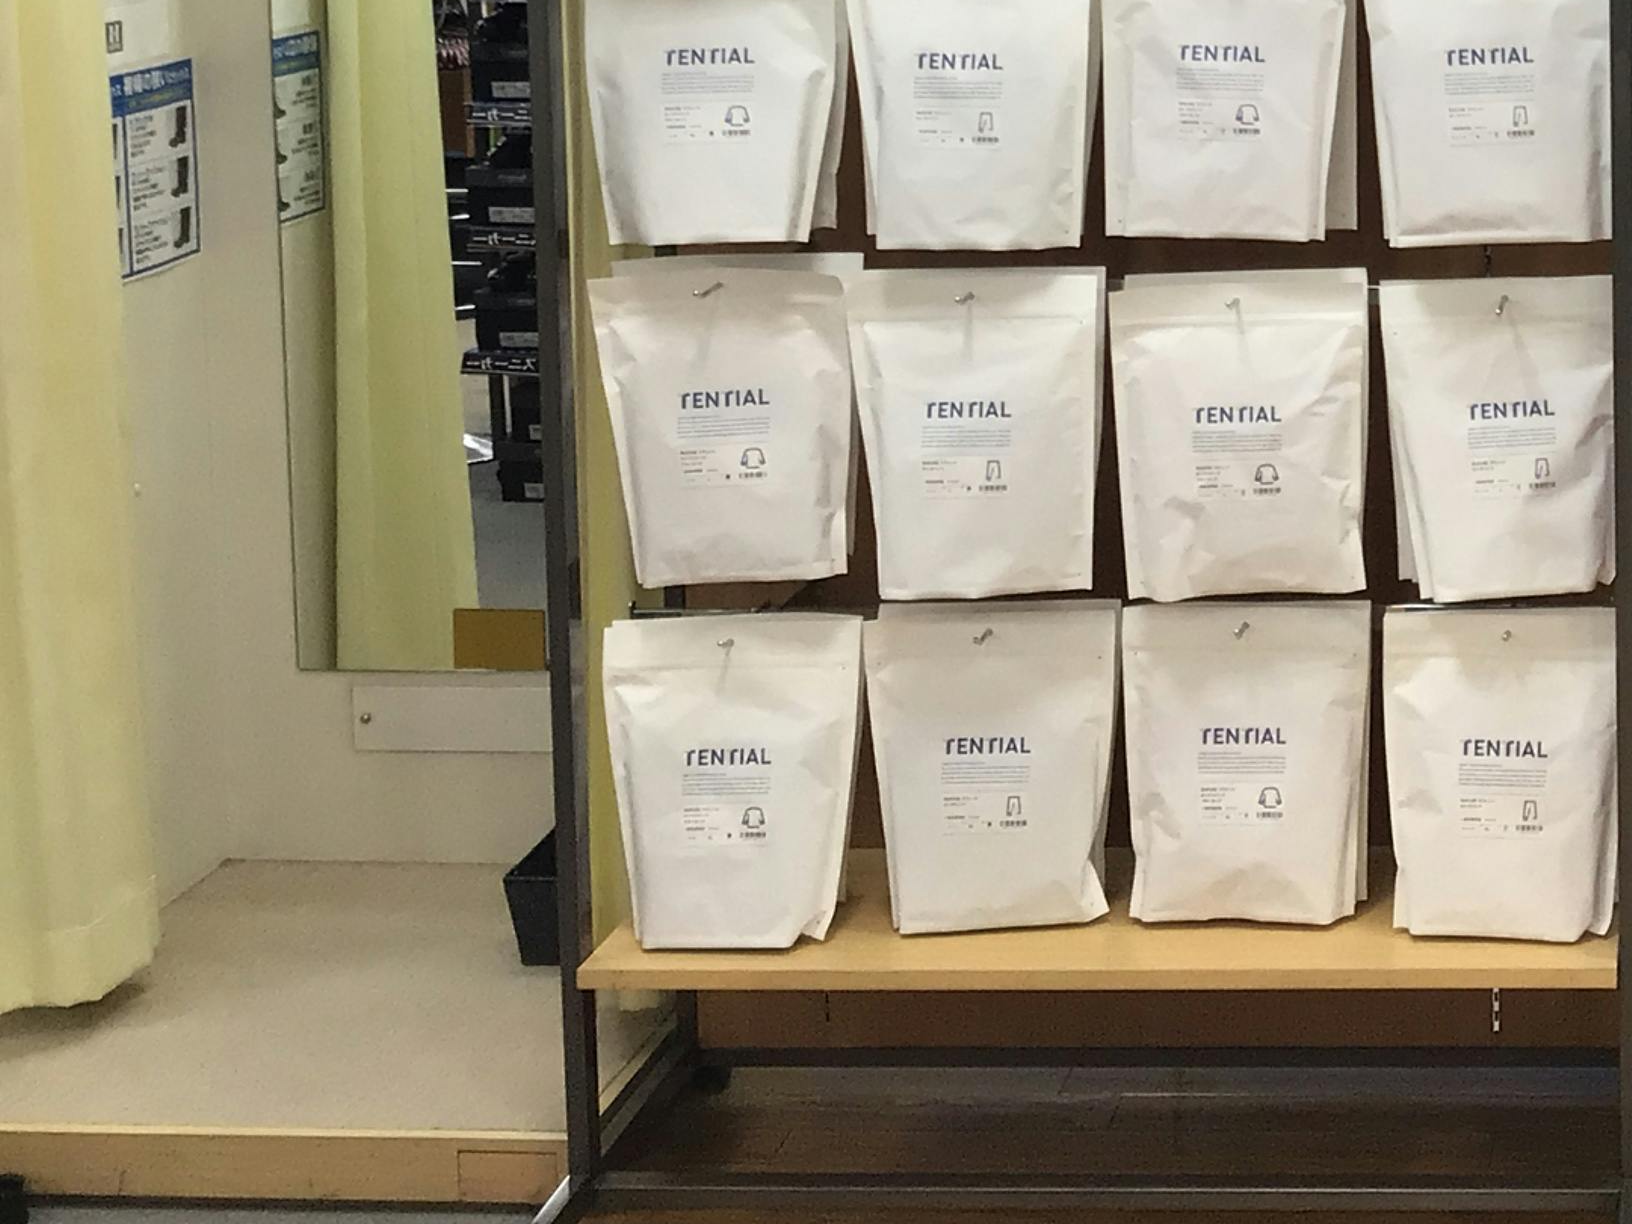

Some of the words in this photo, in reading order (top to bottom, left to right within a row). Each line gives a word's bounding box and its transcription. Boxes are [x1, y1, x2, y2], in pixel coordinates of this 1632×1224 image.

[666, 47, 755, 67] TENTIAL
[917, 52, 1003, 71] TENTIAL
[1180, 44, 1266, 63] TENTIAL
[1446, 46, 1535, 67] TENTIAL
[680, 388, 770, 410] TENTIAL
[926, 400, 1012, 419] TENTIAL
[1195, 405, 1282, 424] TENTIAL
[1469, 399, 1556, 421] TENTIAL
[945, 736, 1031, 756] TENTIAL
[1202, 727, 1287, 745] TENTIAL
[686, 747, 772, 767] TENTIAL
[1463, 738, 1549, 759] TENTIAL
